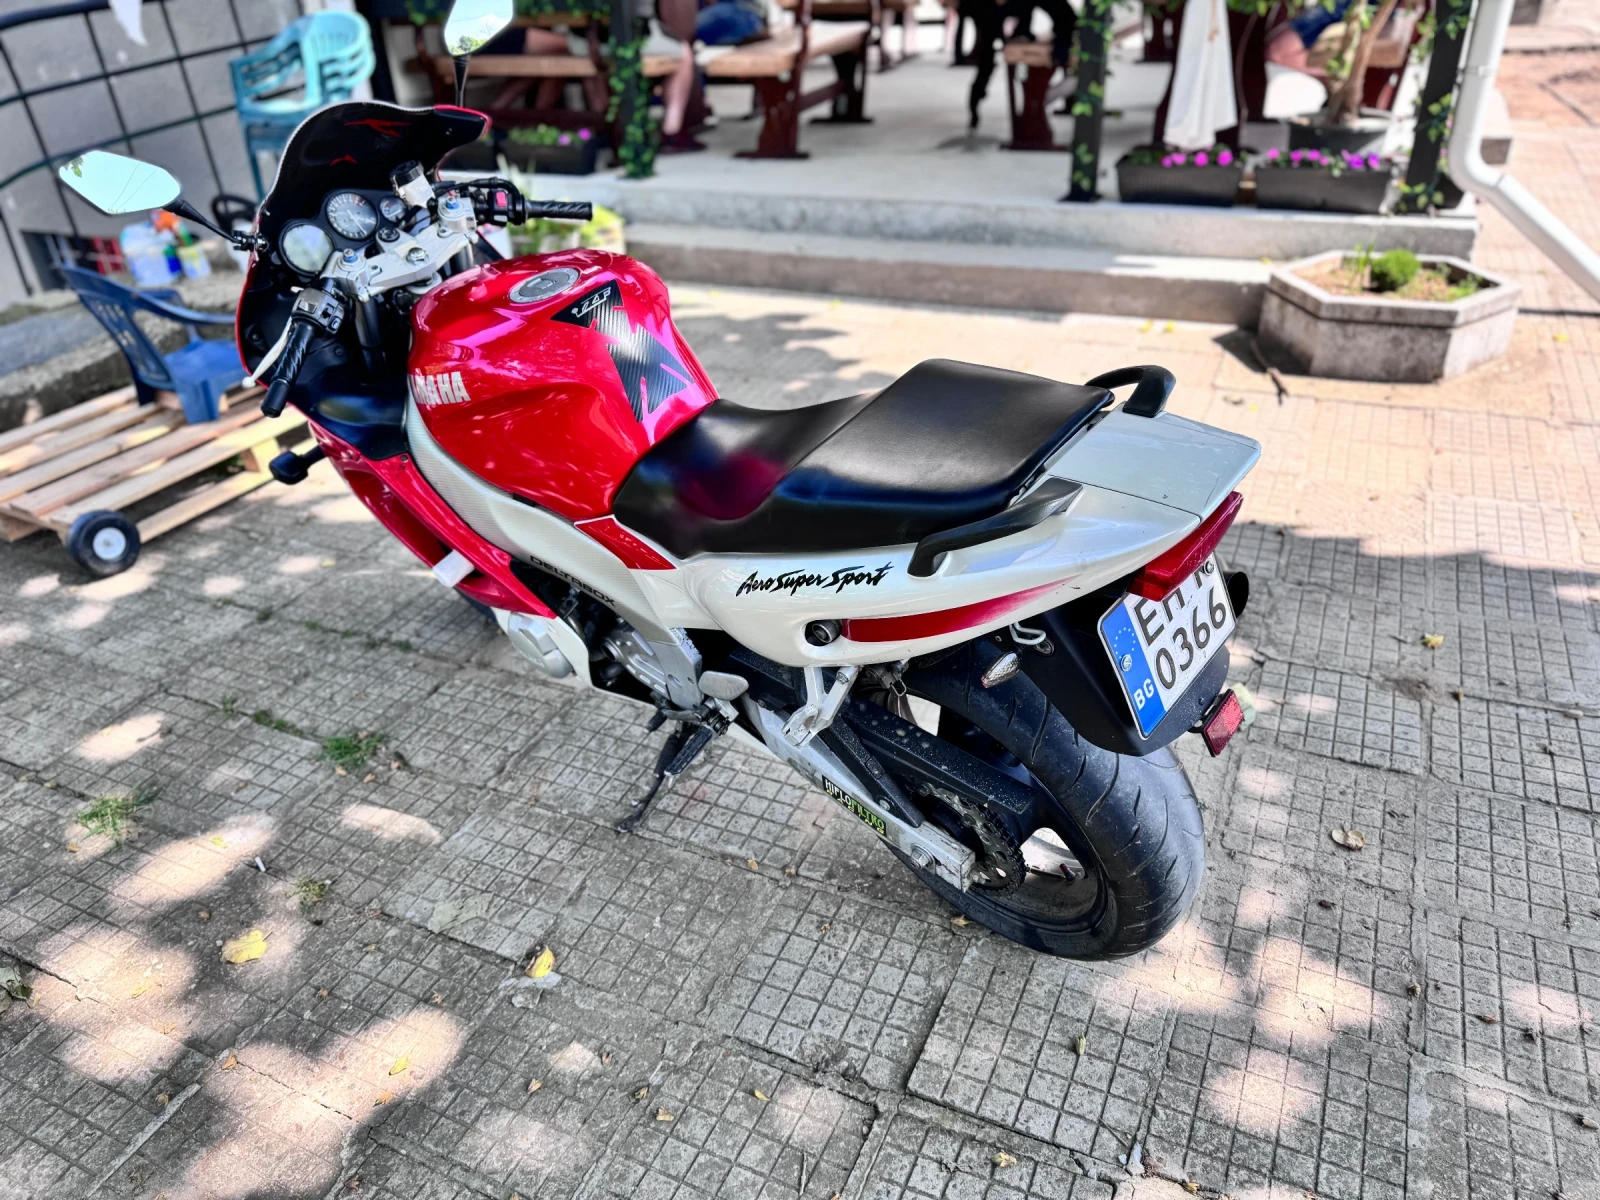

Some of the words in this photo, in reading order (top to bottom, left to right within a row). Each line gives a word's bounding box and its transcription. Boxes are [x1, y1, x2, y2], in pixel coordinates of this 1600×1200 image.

[529, 555, 616, 607] DELTABOX
[821, 560, 895, 594] Sport
[1155, 585, 1227, 690] 0366
[1133, 678, 1155, 711] BG
